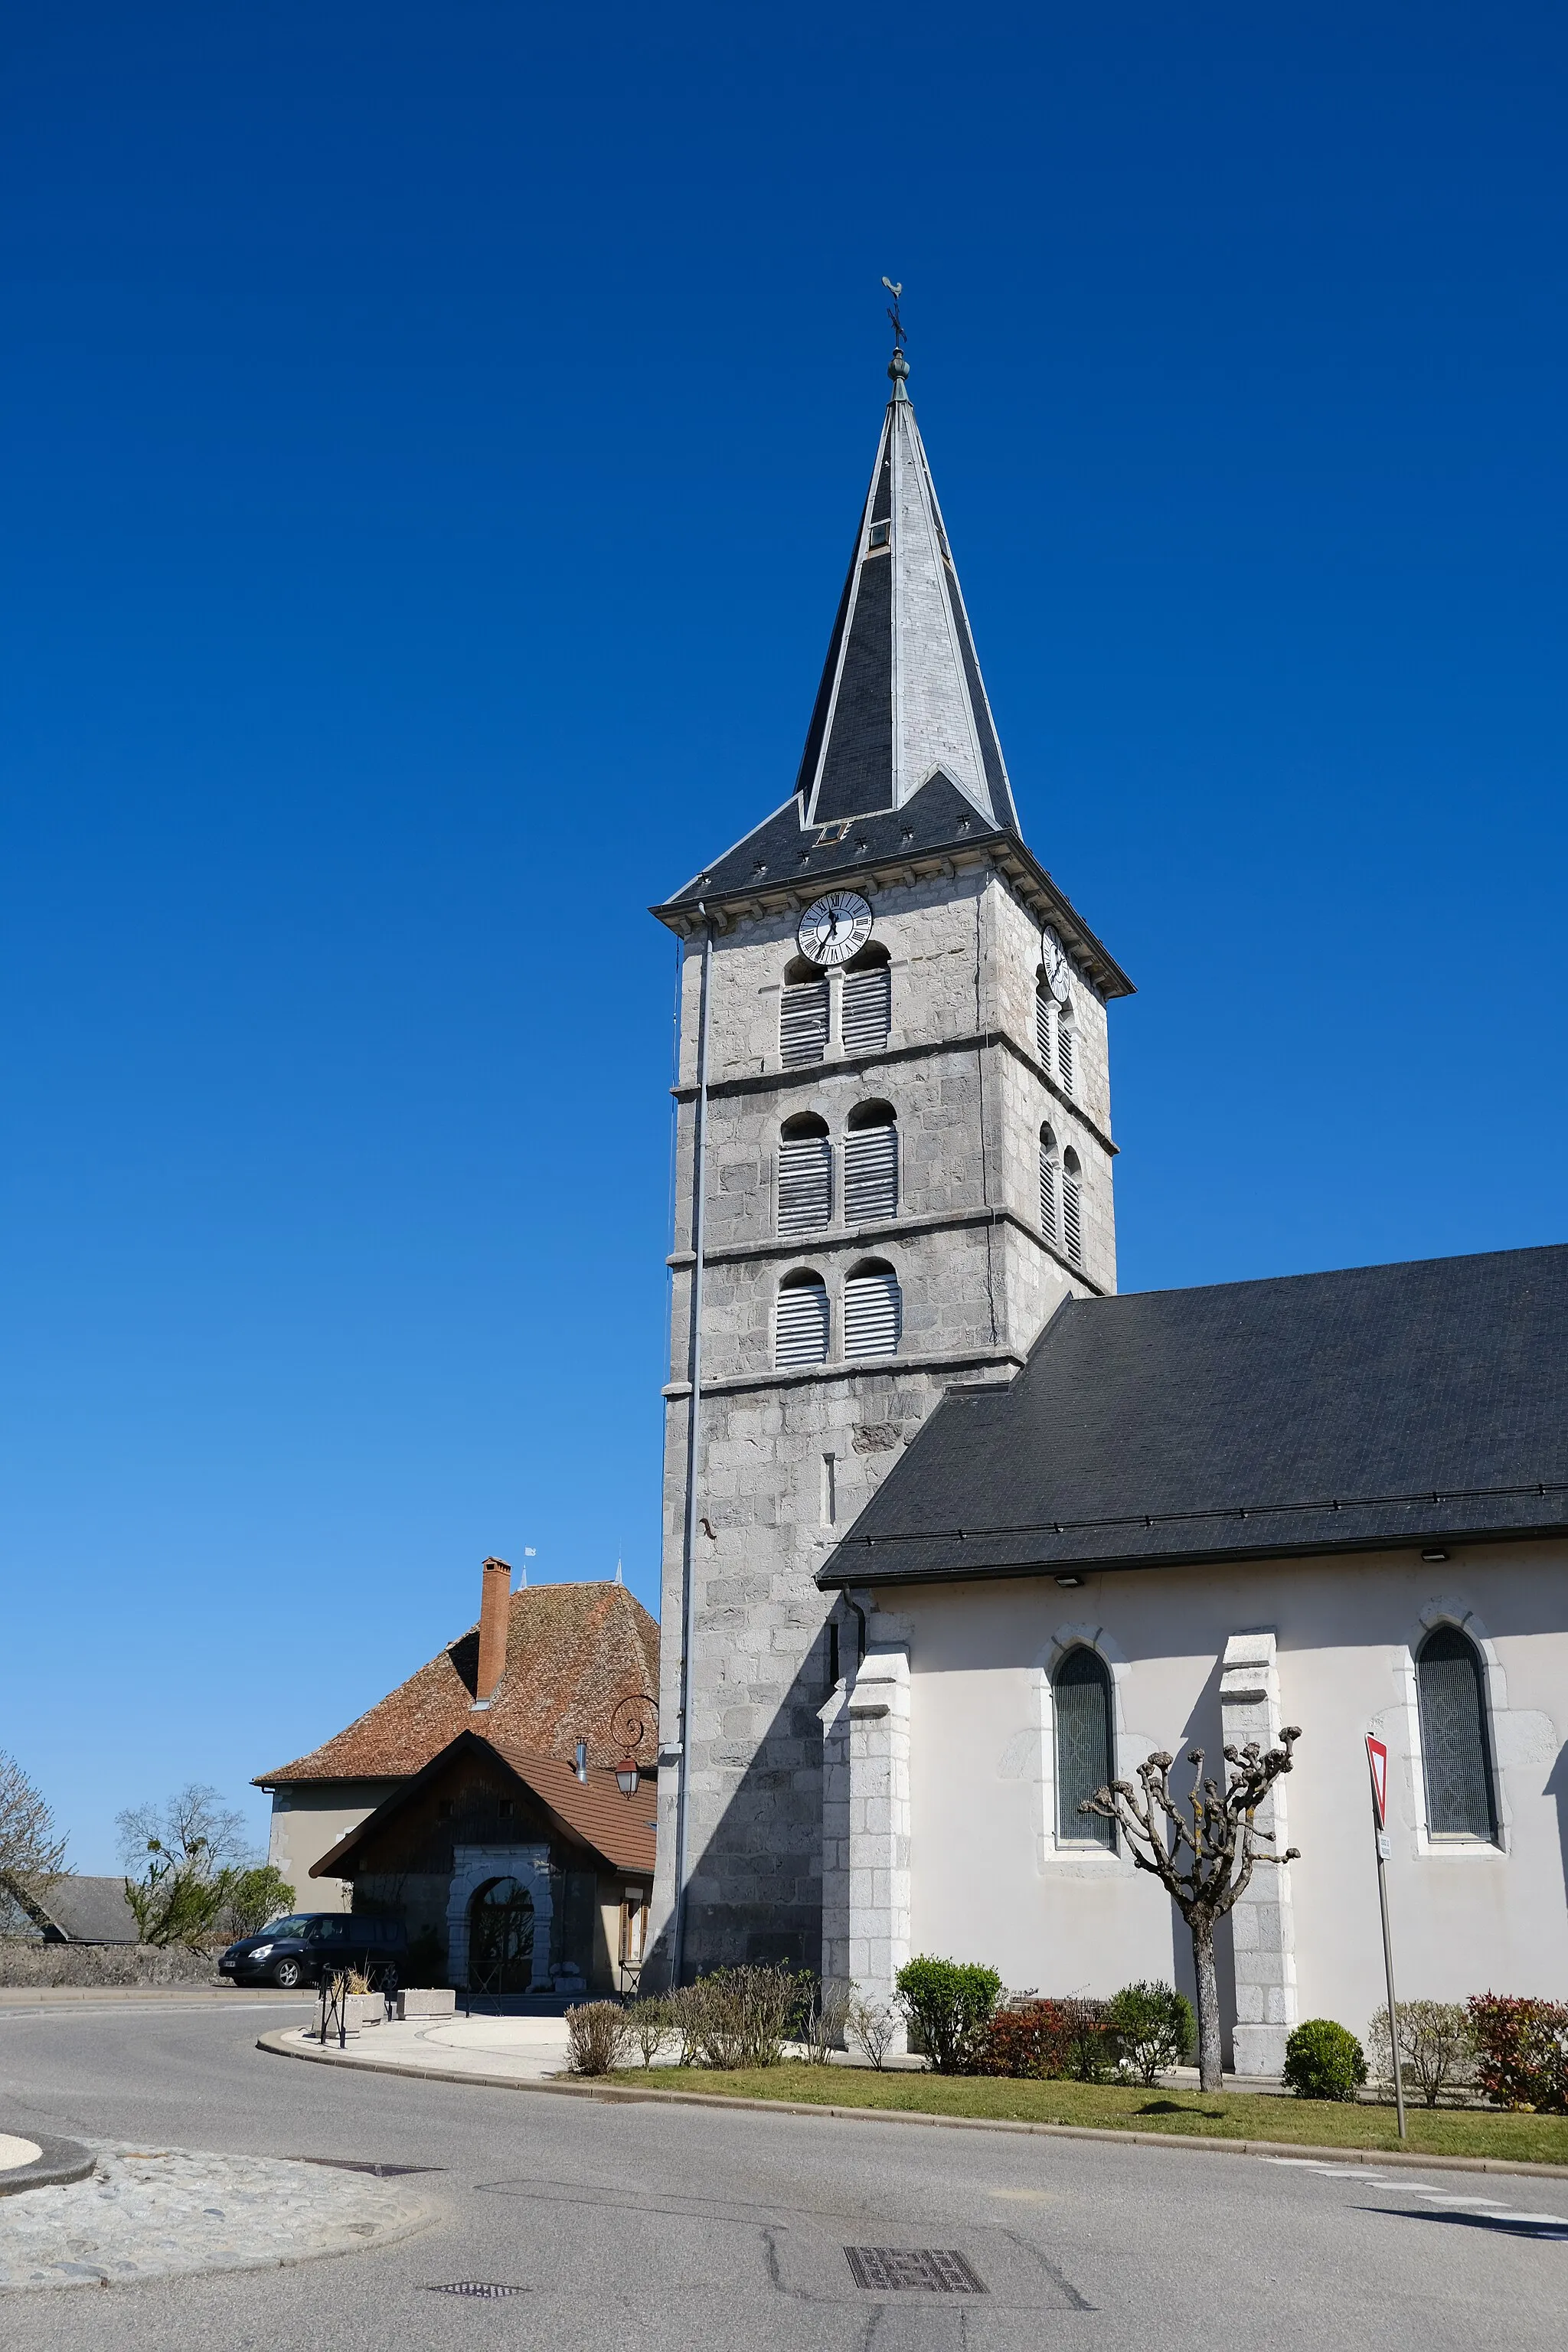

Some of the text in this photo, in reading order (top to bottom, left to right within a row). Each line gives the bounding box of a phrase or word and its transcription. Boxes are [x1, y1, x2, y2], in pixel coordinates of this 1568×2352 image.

[816, 901, 827, 913] XI
[831, 895, 839, 907] XII
[853, 904, 864, 915] II
[831, 949, 838, 961] VI
[845, 944, 853, 954] V
